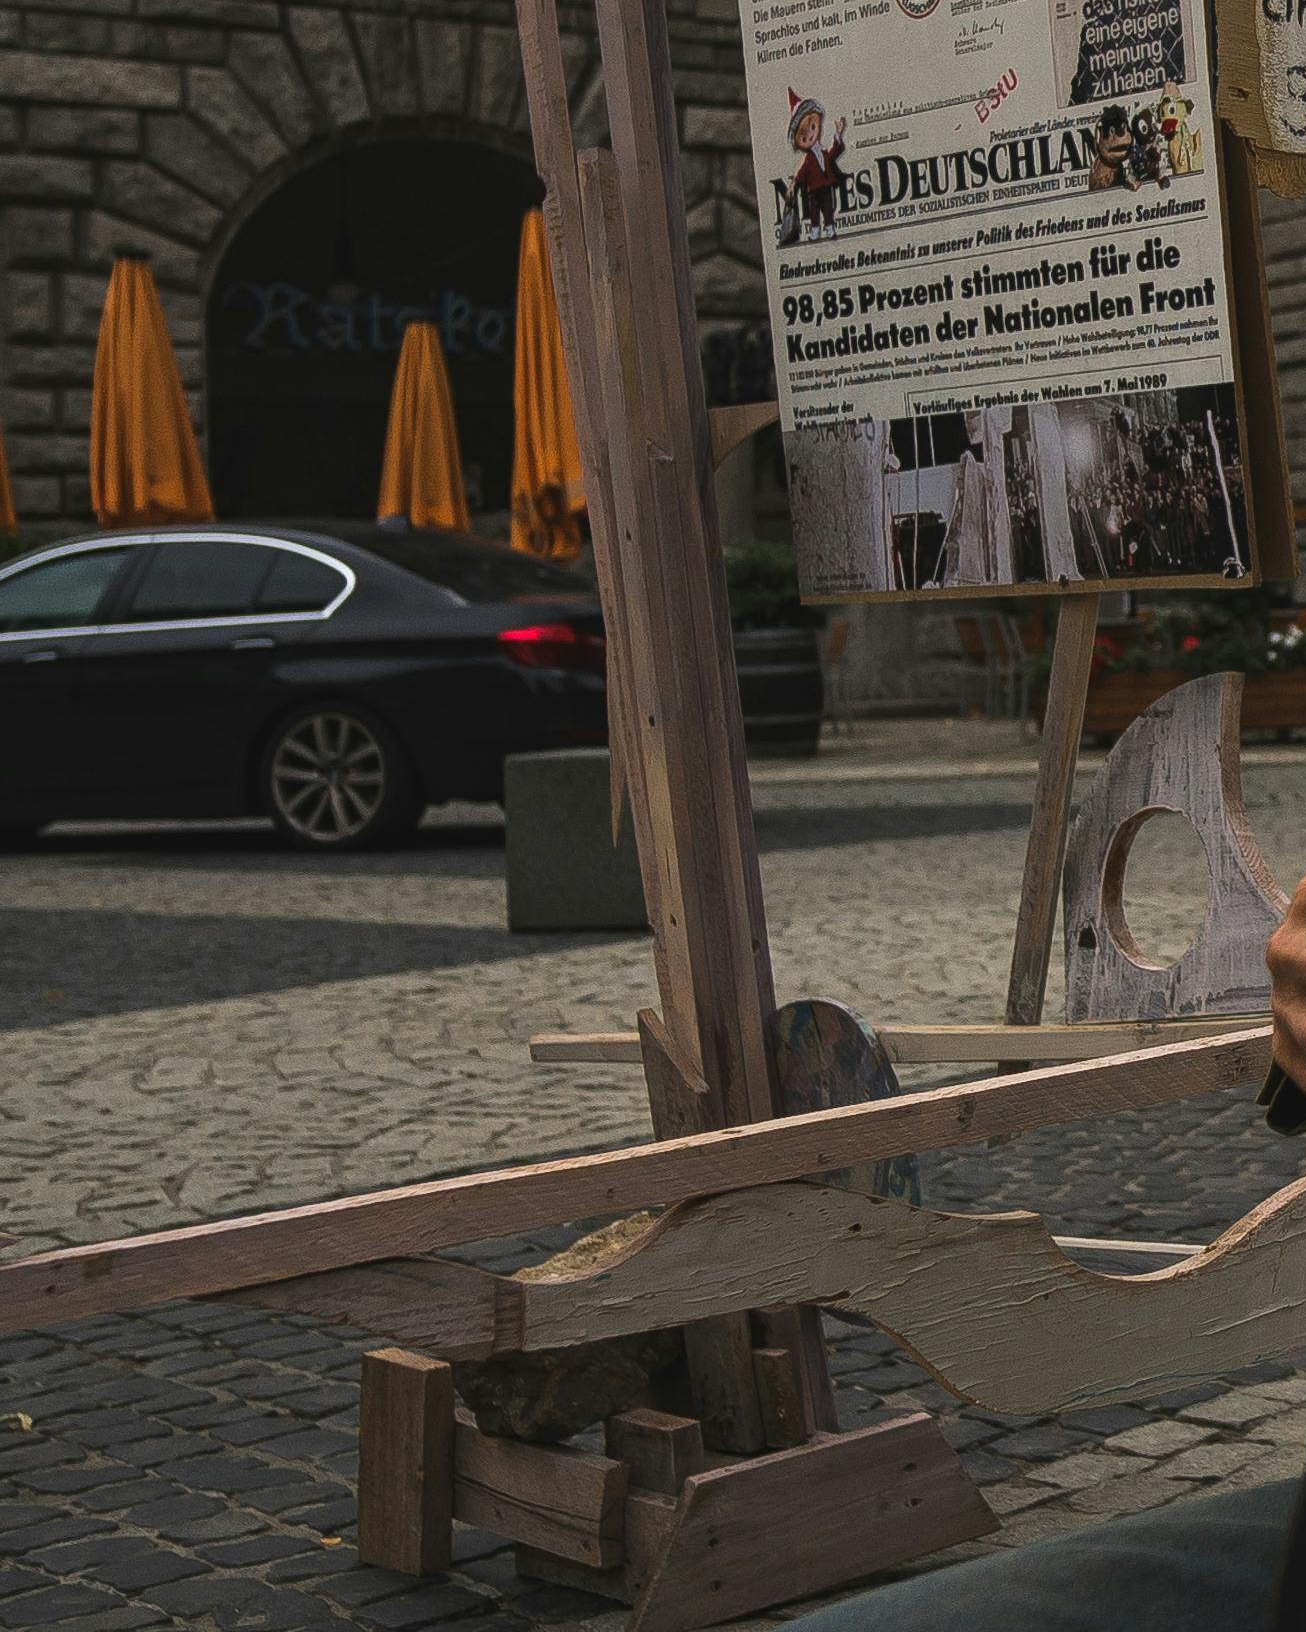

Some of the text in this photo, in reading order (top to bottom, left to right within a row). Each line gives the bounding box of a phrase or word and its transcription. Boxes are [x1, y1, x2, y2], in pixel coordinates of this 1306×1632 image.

[753, 8, 769, 24] Die
[770, 1, 806, 21] Mauern
[755, 0, 890, 46] Sprachlos und kalt, im Winde
[1085, 6, 1180, 45] eine eigene
[757, 34, 843, 64] Klirren die Fahnen.
[1089, 38, 1164, 71] meinung
[1091, 78, 1112, 98] zu
[1029, 122, 1047, 135] aller
[874, 127, 1098, 207] DEUTSCHLAN
[831, 173, 1090, 229] NTRALKOMITEES DER SOZIALISTISCHEN EINHEITSPARTEI DEUT
[779, 197, 1206, 281] Eindrucksvolles Bekenntnis zu unserer Politik des Friedens und des Sozialismus
[782, 237, 1181, 327] 98,85 Prozent stimmten für die
[787, 277, 1215, 363] Kandidaten der Nationalen Front
[1158, 335, 1191, 347] Jahrestag
[1191, 331, 1203, 343] der
[1204, 329, 1220, 341] DDR
[912, 373, 1168, 415] Vorläufiges Ergebnis der Wahlen am 7. Mai 1989
